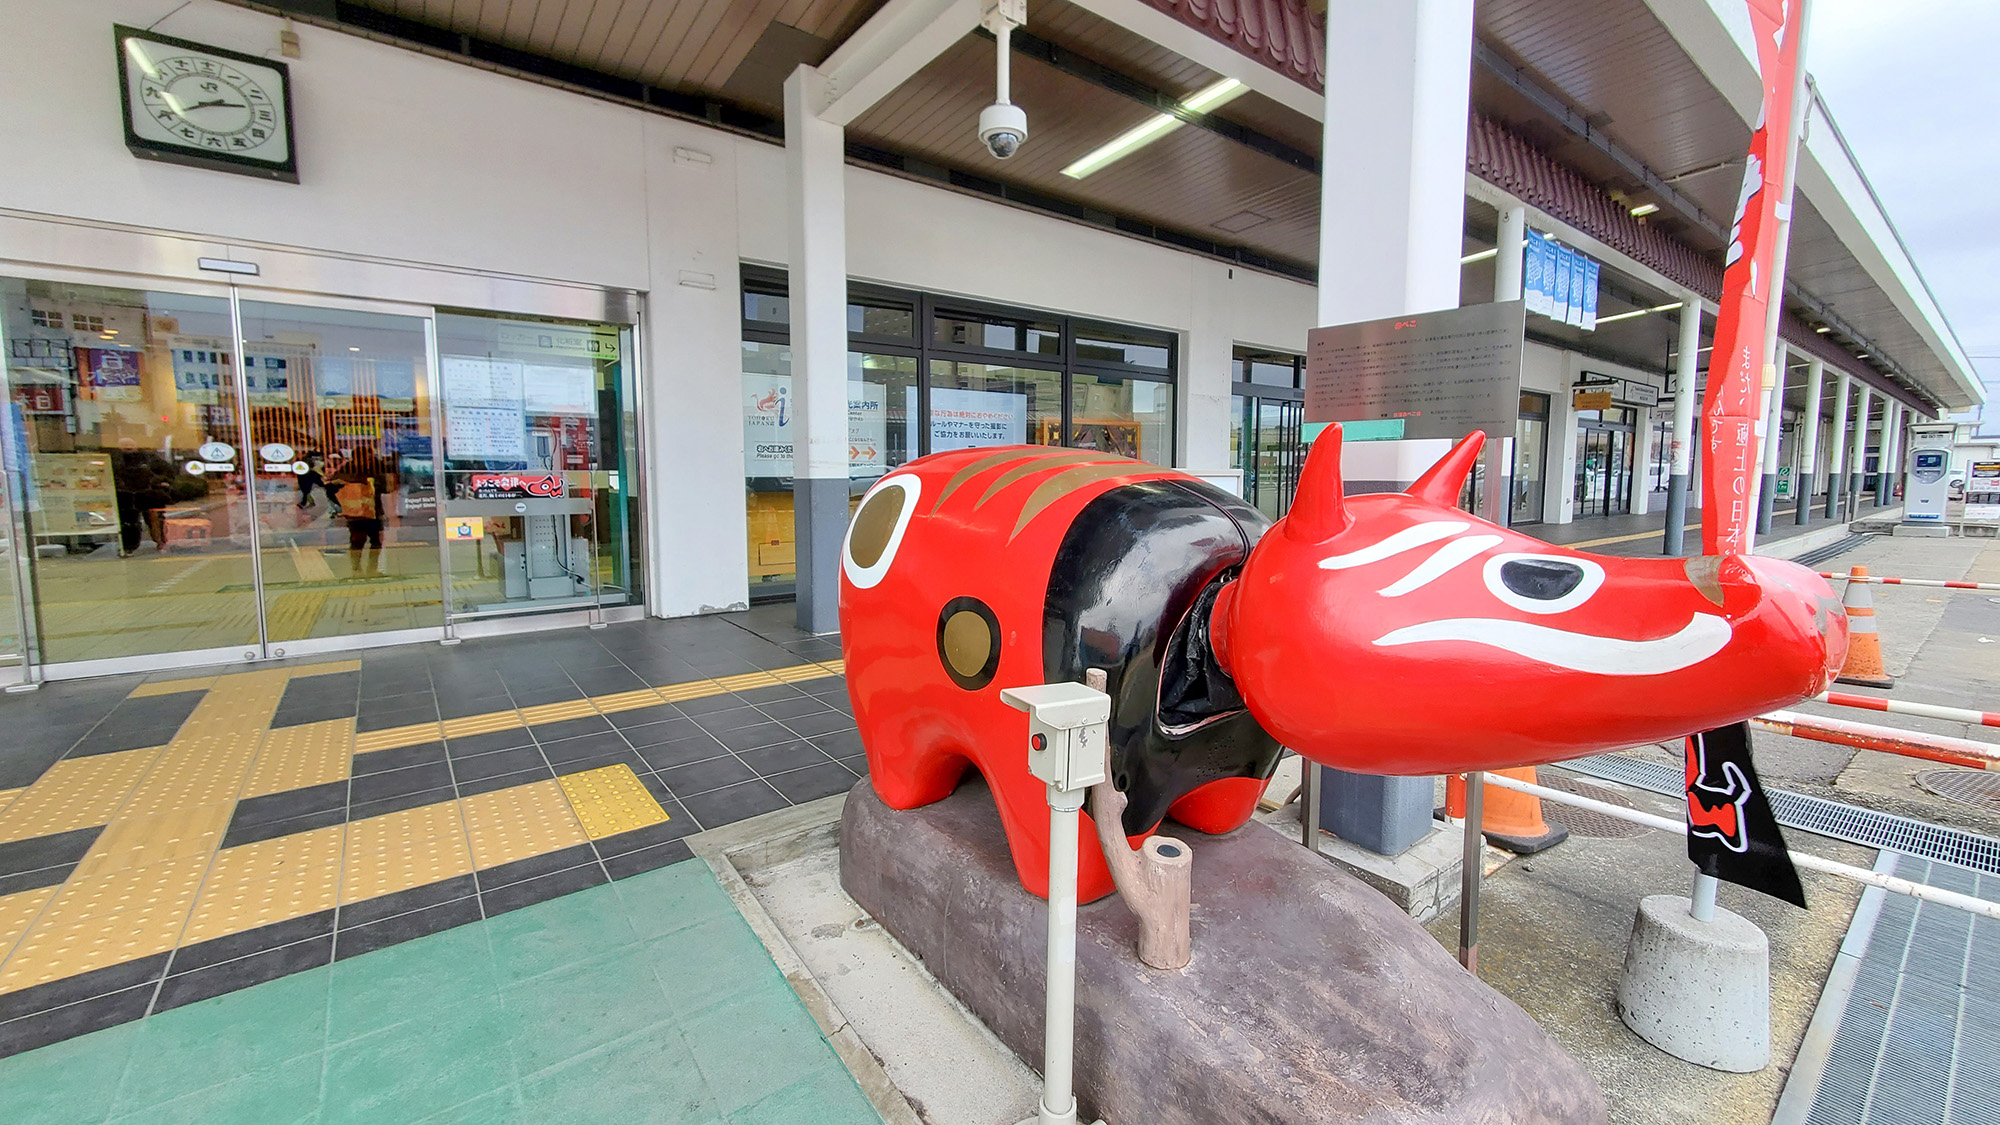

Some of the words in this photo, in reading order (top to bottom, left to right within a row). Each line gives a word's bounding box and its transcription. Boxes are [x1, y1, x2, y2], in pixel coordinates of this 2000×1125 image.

[200, 82, 218, 92] JR
[145, 86, 162, 100] 九
[250, 89, 263, 100] 二
[258, 109, 273, 123] 三
[180, 127, 195, 139] 七
[252, 128, 266, 140] 四
[206, 136, 222, 148] 六
[232, 137, 248, 148] 五
[934, 430, 1005, 440] ご協力をお願いいたします。
[475, 477, 527, 488] ようこそ会津へ
